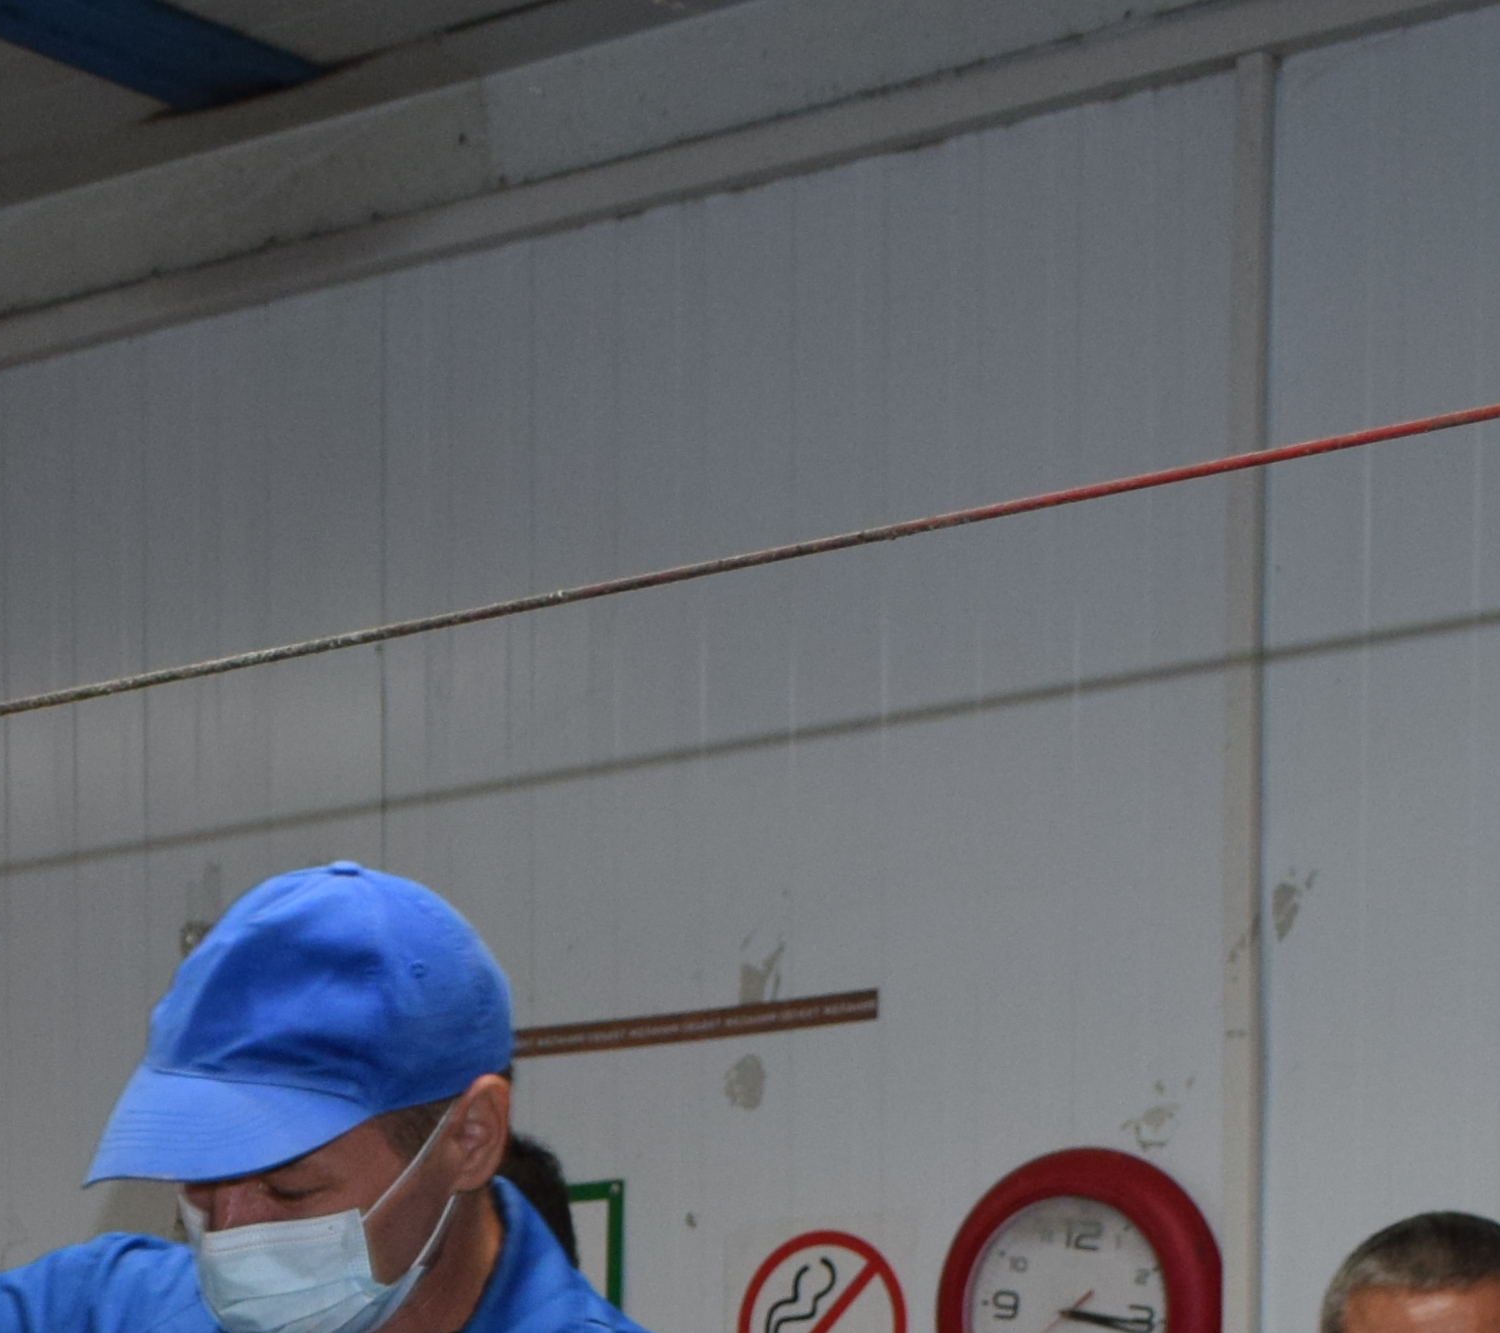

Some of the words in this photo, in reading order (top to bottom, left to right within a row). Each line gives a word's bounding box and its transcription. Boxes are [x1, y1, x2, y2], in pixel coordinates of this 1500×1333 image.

[1065, 1221, 1102, 1251] 12
[1009, 1256, 1029, 1273] 10
[1134, 1268, 1149, 1286] 2
[992, 1290, 1020, 1320] 9
